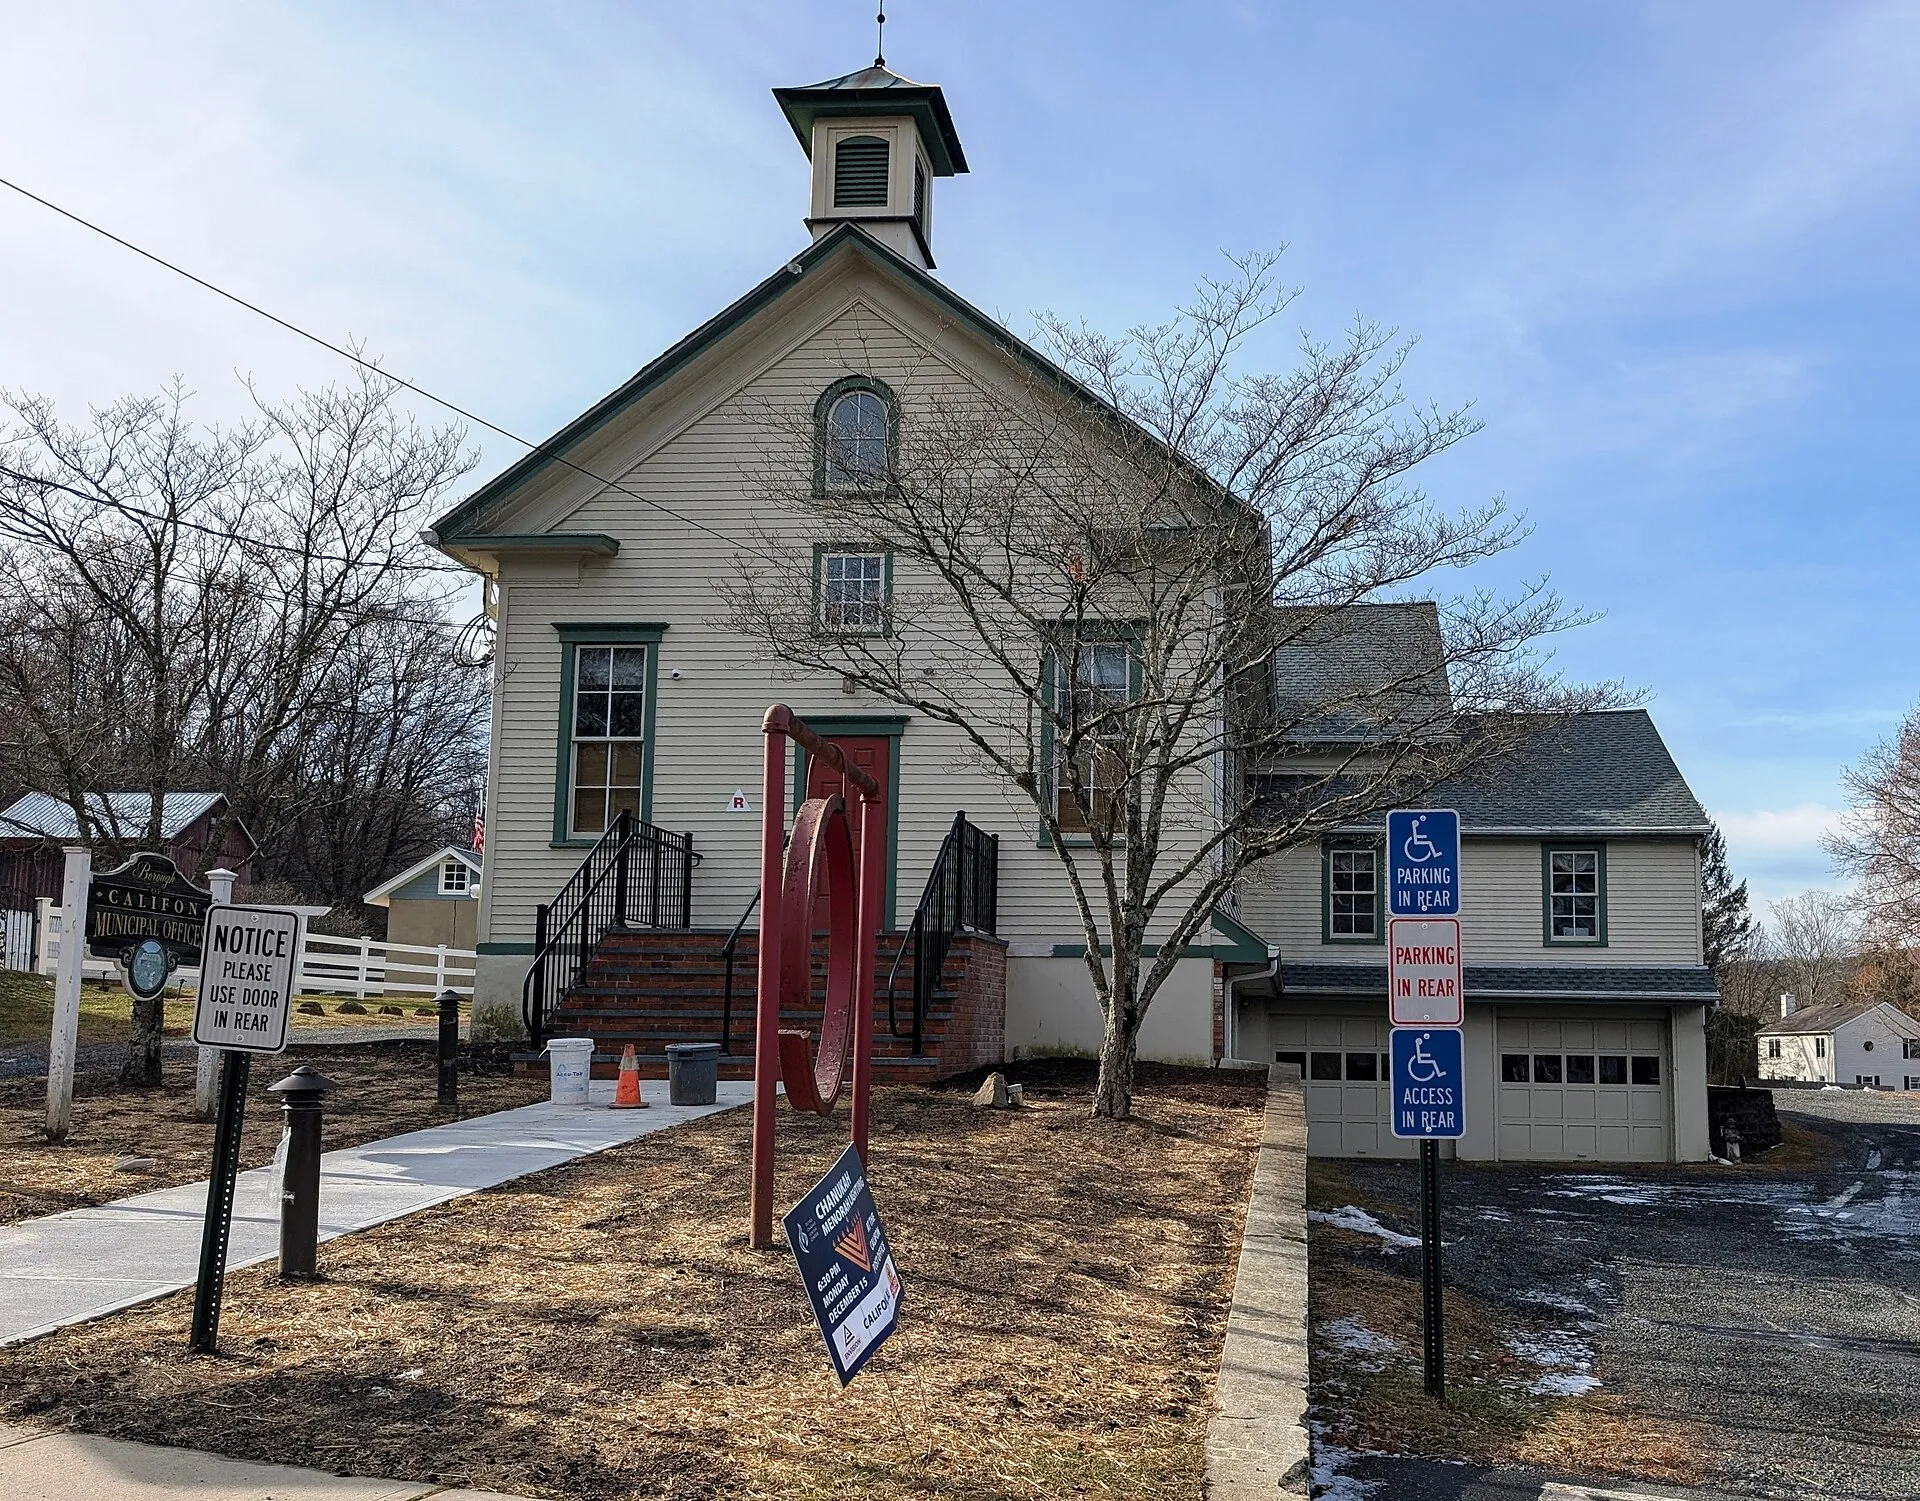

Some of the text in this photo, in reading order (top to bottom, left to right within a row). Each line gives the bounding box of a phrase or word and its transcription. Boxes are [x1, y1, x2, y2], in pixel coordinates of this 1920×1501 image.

[132, 861, 176, 888] Borough
[1397, 867, 1451, 884] PARKING
[108, 889, 198, 916] CALIFON
[1398, 890, 1451, 907] IN REAR
[93, 911, 160, 937] MUNICIPAL
[213, 924, 289, 958] NOTICE
[1396, 947, 1455, 965] PARKING
[222, 961, 273, 982] PLEASE
[210, 985, 279, 1008] USE DOOR
[1397, 979, 1455, 997] IN REAR
[213, 1010, 269, 1032] IN REAR
[1403, 1088, 1453, 1105] ACCESS
[1402, 1111, 1455, 1129] IN REAR
[815, 1170, 852, 1220] CHANUKAH
[821, 1195, 851, 1237] MENORAH
[817, 1262, 842, 1292] 6:30 PM
[822, 1274, 850, 1308] MONDAY
[828, 1276, 869, 1324] DECEMBER 15
